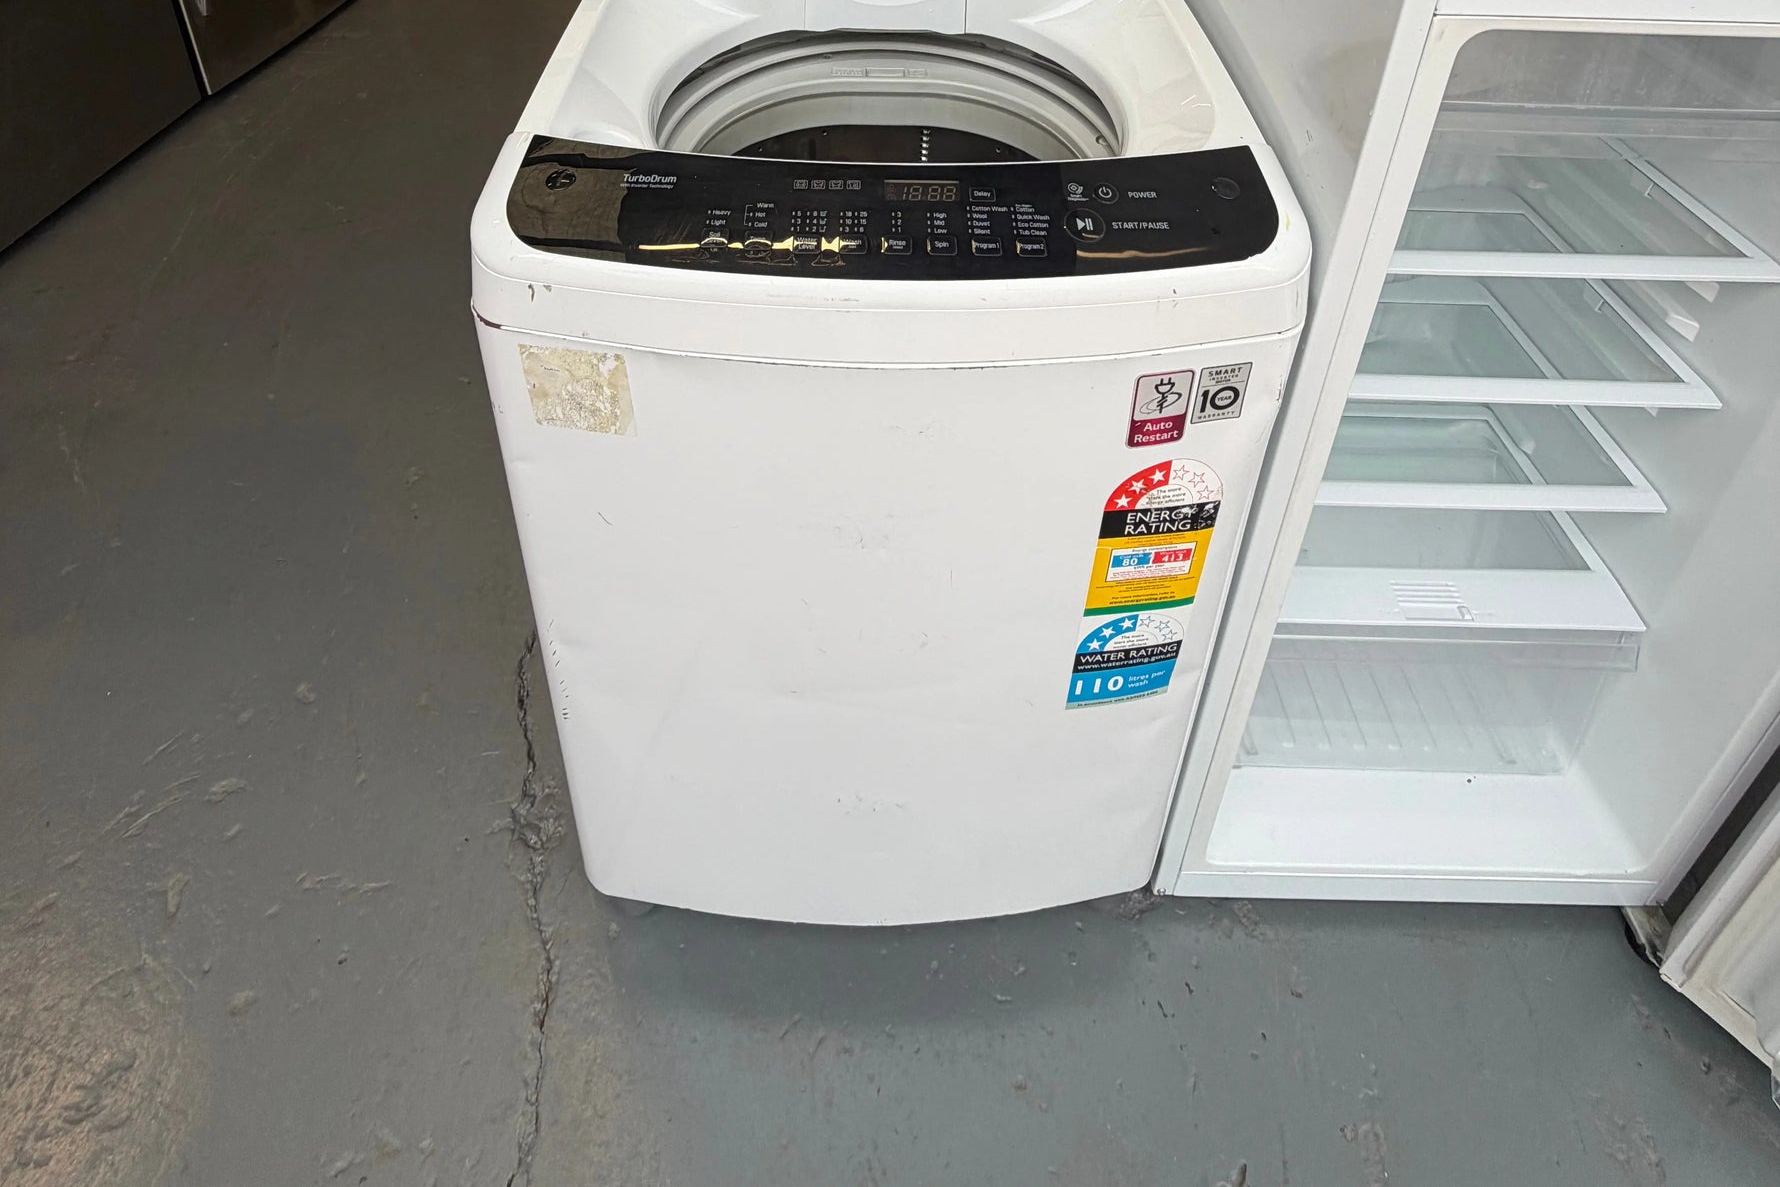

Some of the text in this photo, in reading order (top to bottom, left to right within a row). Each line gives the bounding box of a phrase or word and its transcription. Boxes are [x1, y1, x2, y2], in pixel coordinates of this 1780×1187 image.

[624, 174, 677, 183] TurboDrum
[1208, 367, 1243, 377] SMART
[1200, 386, 1240, 413] 10
[1143, 421, 1173, 432] Auto
[1134, 430, 1178, 443] Restart
[1127, 509, 1194, 523] ENERGY
[1124, 520, 1191, 535] RATING
[1162, 554, 1184, 562] 413
[1080, 644, 1177, 663] WATER RATING
[1077, 652, 1176, 670] www.waterrating.gov.au
[1151, 670, 1165, 678] per
[1074, 676, 1124, 695] 110
[1128, 680, 1148, 688] wash
